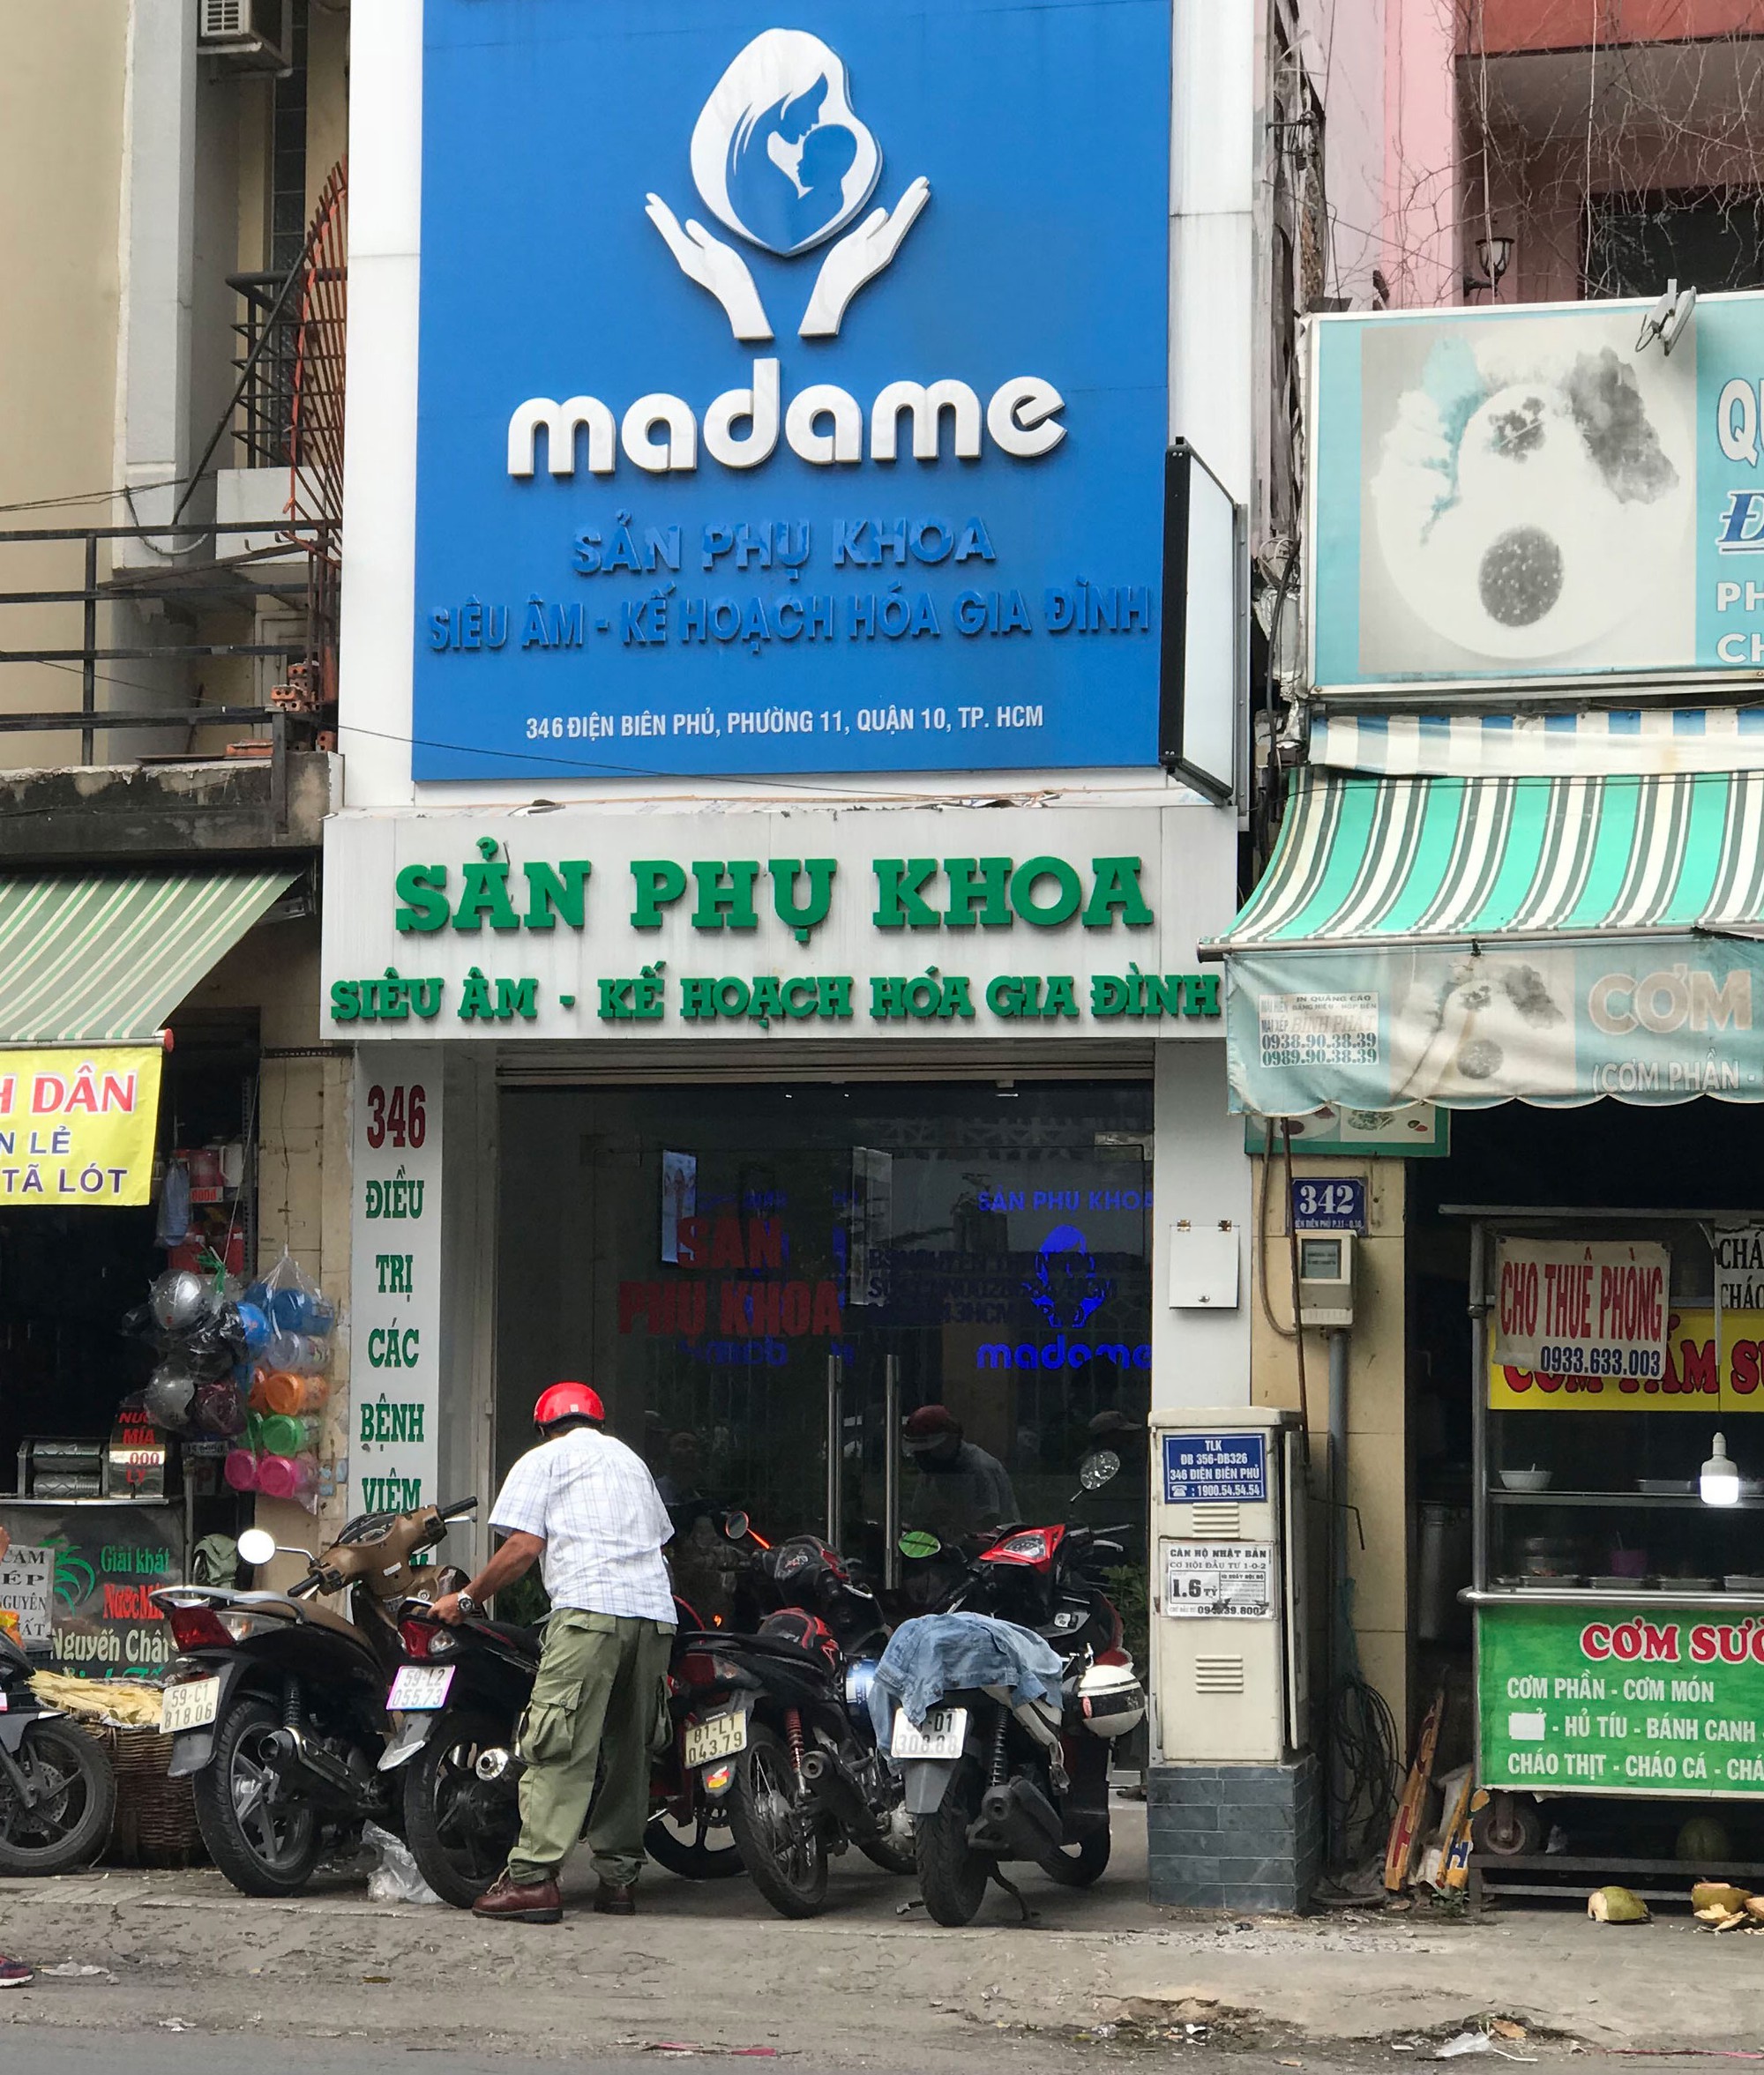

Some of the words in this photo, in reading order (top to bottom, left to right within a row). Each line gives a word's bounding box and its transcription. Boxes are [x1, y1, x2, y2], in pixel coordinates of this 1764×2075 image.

[507, 358, 1068, 477] madame
[1717, 378, 1764, 467] Q
[573, 509, 682, 576] SẢN
[702, 518, 811, 581] PHỤ
[833, 515, 997, 568] KHOA
[429, 594, 510, 651] SIÊU
[521, 596, 585, 650] ÂM
[622, 582, 676, 646] KẾ
[679, 592, 834, 656] HOẠCH
[847, 581, 940, 638] HÓA
[957, 588, 1033, 635] GIA
[1043, 574, 1149, 633] ĐÌNH
[526, 717, 564, 739] 346
[567, 712, 615, 742] ĐIỆN
[621, 710, 666, 737] BIÊN
[674, 707, 721, 738] PHỦ,
[728, 705, 813, 734] PHƯỜNG
[820, 710, 850, 735] 11,
[857, 705, 914, 735] QUẬN
[921, 707, 952, 733] 10,
[958, 707, 989, 729] TP.
[997, 705, 1043, 728] HCM
[395, 836, 592, 932] SẢN
[630, 858, 838, 943] PHỤ
[872, 856, 1155, 929] KHOA
[330, 968, 445, 1021] SIÊU
[458, 967, 539, 1019] ÂM
[597, 961, 668, 1020] KẾ
[679, 974, 855, 1029] HOẠCH
[870, 967, 977, 1020] HÓA
[985, 975, 1081, 1019] GIA
[1090, 962, 1222, 1018] ĐÌNH
[1588, 963, 1753, 1035] CƠM
[1262, 1033, 1377, 1049] 0938.90.38.39
[1262, 1049, 1377, 1066] 0989.90.38.39
[1669, 1047, 1739, 1091] PHẦN
[32, 1064, 134, 1114] DÂN
[366, 1085, 426, 1148] 346
[30, 1125, 71, 1154] LẺ
[2, 1163, 43, 1193] TÃ
[59, 1162, 128, 1193] LÓT
[365, 1164, 425, 1220] ĐIỀU
[1033, 1191, 1080, 1217] PHỤ
[1299, 1184, 1355, 1215] 342
[375, 1254, 414, 1302] TRỊ
[1500, 1261, 1538, 1338] CHO
[1544, 1247, 1594, 1340] THUÊ
[1598, 1247, 1663, 1343] PHÒNG
[721, 1280, 844, 1337] KHOA
[367, 1317, 420, 1368] CÁC
[1541, 1345, 1661, 1377] 0933.633.003
[1730, 1339, 1764, 1395] S
[360, 1392, 424, 1452] BỆNH
[1205, 1440, 1222, 1452] TLK
[362, 1467, 422, 1514] VIÊM
[1170, 1469, 1188, 1481] 346
[1215, 1466, 1237, 1480] BIÊN
[1240, 1464, 1259, 1479] PHỦ
[1197, 1483, 1260, 1497] 1900.54.54.54
[136, 1547, 170, 1576] khát
[0, 1592, 47, 1610] GUYÊN
[1582, 1616, 1680, 1661] CƠM
[171, 1683, 209, 1708] 59-C1
[1507, 1675, 1548, 1699] CƠM
[1555, 1668, 1605, 1700] PHẦN
[1623, 1675, 1665, 1701] CƠM
[1671, 1676, 1715, 1703] MÓN
[164, 1702, 213, 1729] 818.06
[694, 1715, 735, 1744] 81-L1
[1565, 1707, 1590, 1737] HỦ
[1596, 1711, 1627, 1738] TÍU
[1646, 1712, 1699, 1741] BÁNH
[1705, 1720, 1756, 1743] CANH
[688, 1731, 743, 1765] 043.79
[1507, 1747, 1558, 1776] CHÁO
[1564, 1753, 1606, 1780] THỊT
[1625, 1750, 1676, 1778] CHÁO
[1682, 1751, 1708, 1780] CÁ
